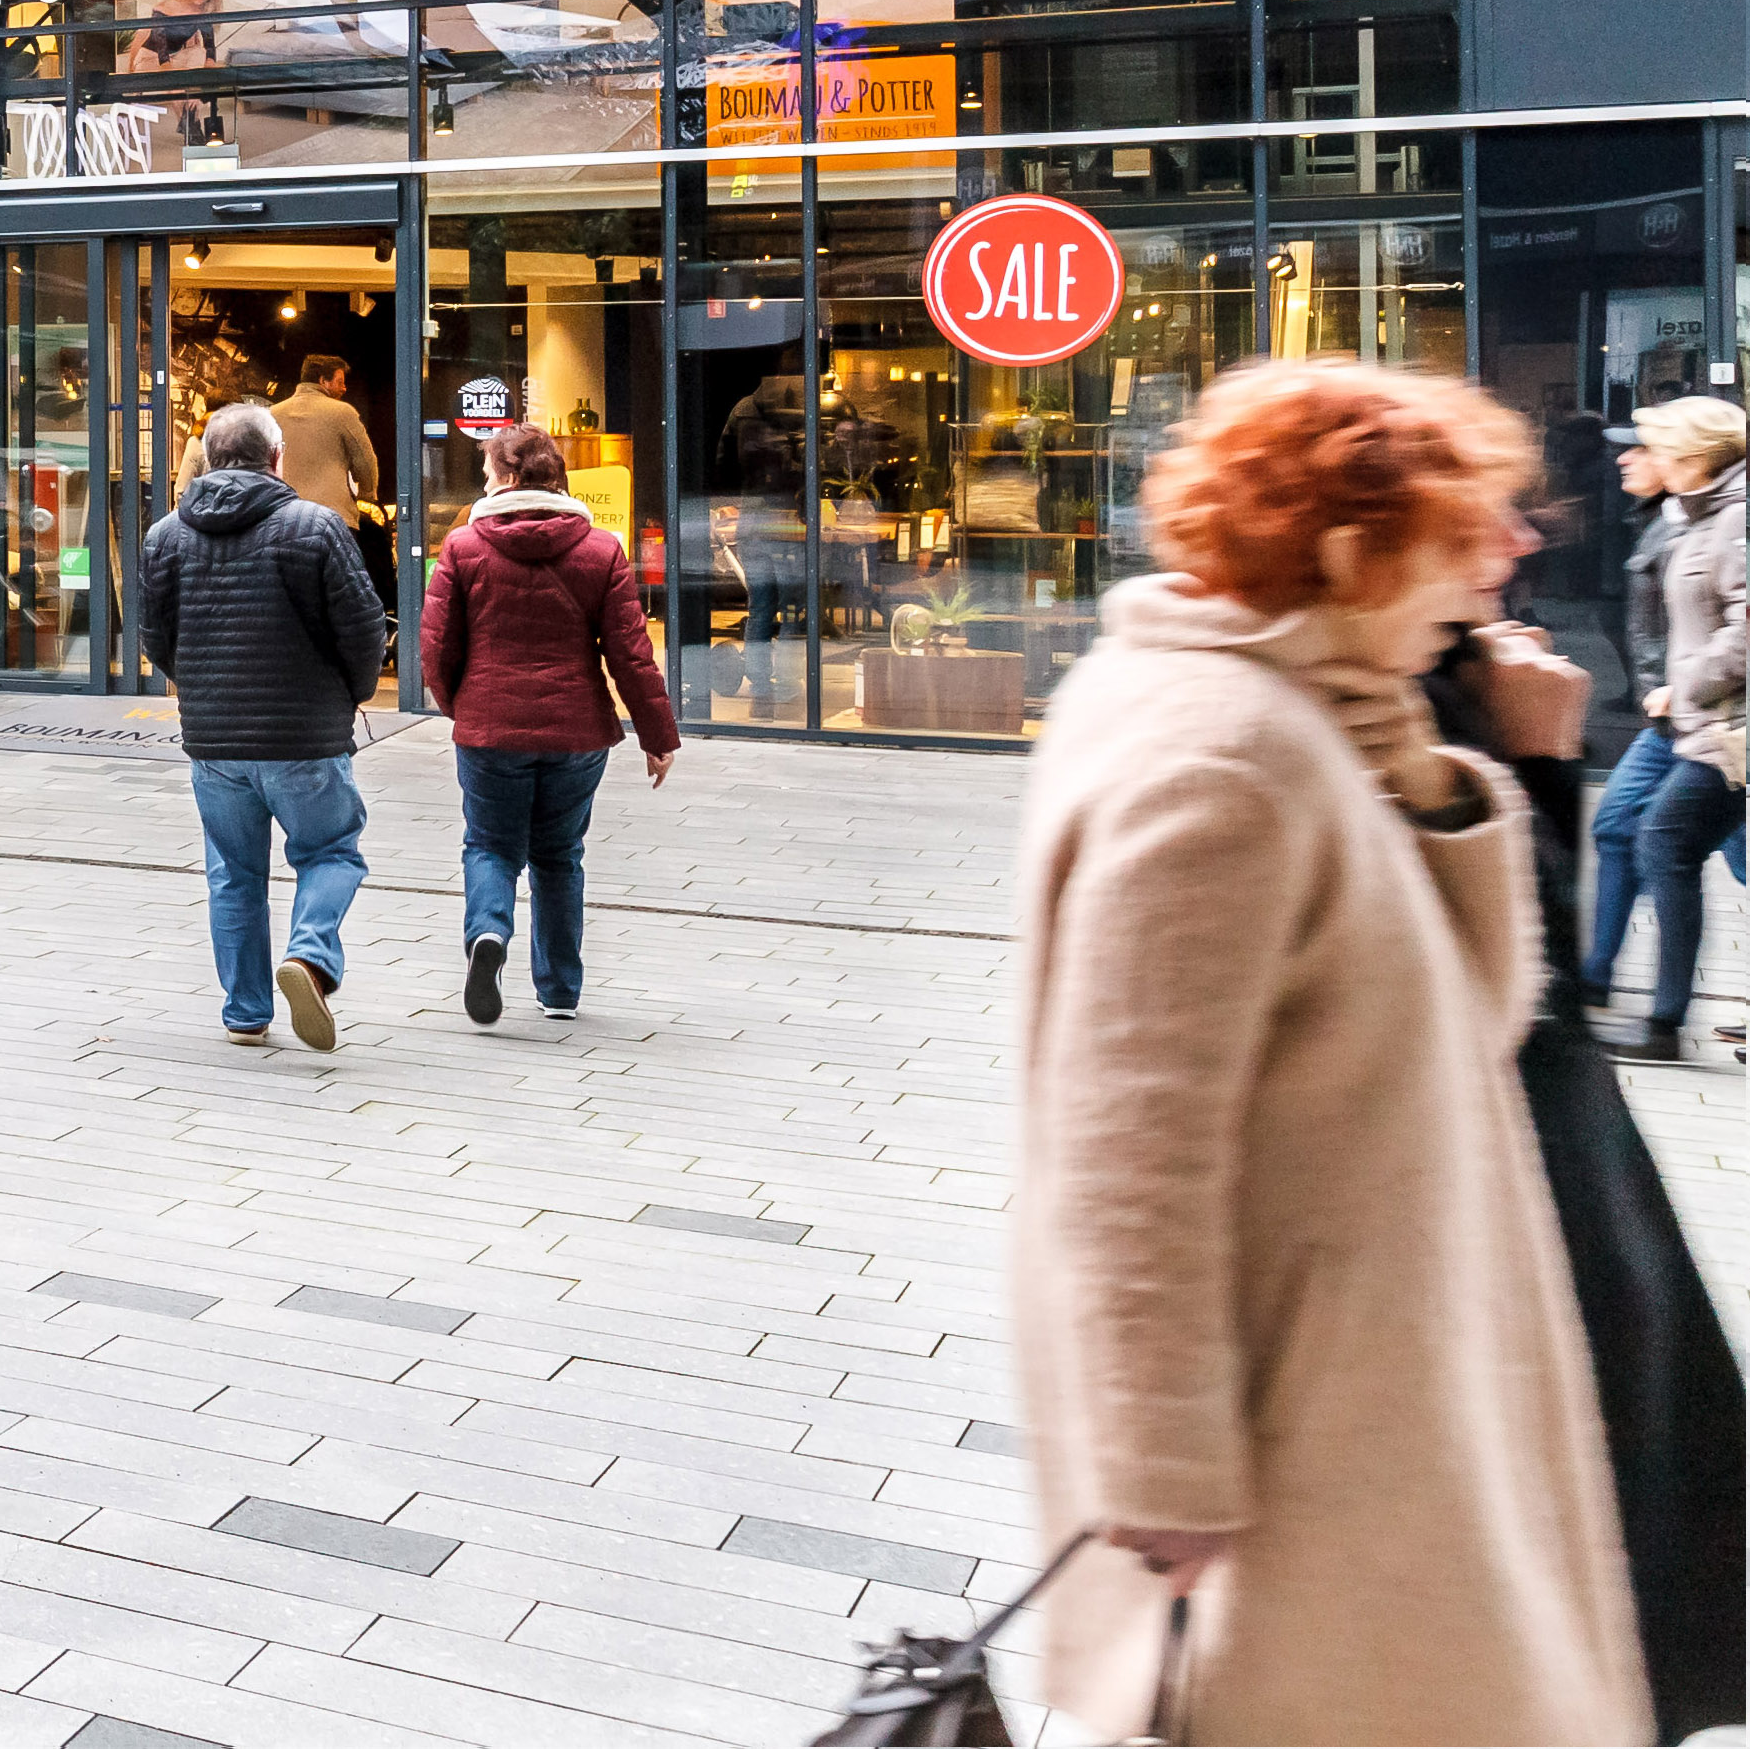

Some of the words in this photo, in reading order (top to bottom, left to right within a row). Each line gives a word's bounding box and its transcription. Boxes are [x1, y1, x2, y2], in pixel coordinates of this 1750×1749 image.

[830, 79, 851, 114] &
[858, 78, 936, 115] POTTER
[965, 240, 1081, 322] SALE
[462, 393, 506, 409] PLEIN
[574, 492, 612, 505] ONZE
